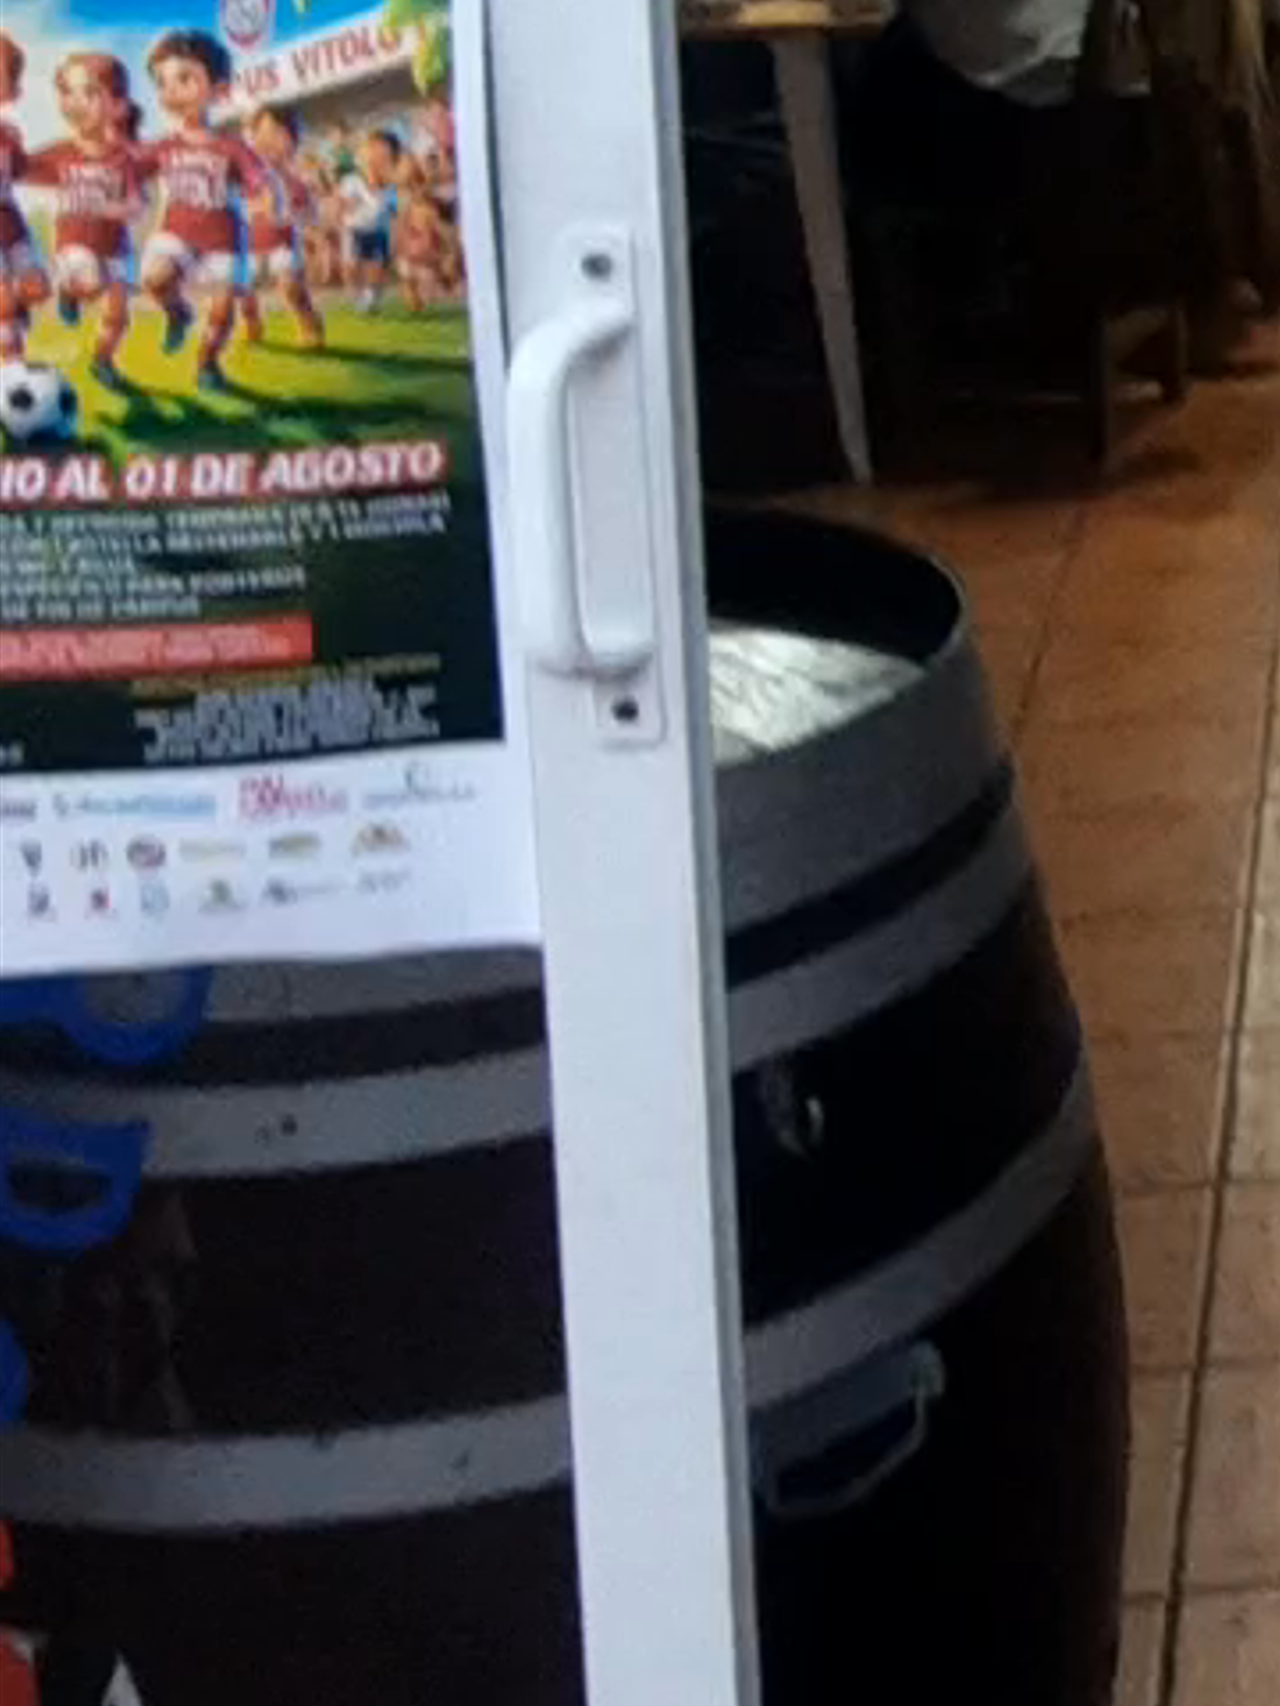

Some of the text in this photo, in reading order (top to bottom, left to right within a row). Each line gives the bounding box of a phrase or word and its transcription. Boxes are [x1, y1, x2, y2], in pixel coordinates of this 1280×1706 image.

[54, 454, 110, 501] AL
[126, 454, 177, 498] 01
[191, 452, 253, 496] DE
[259, 441, 443, 492] AGOSTO
